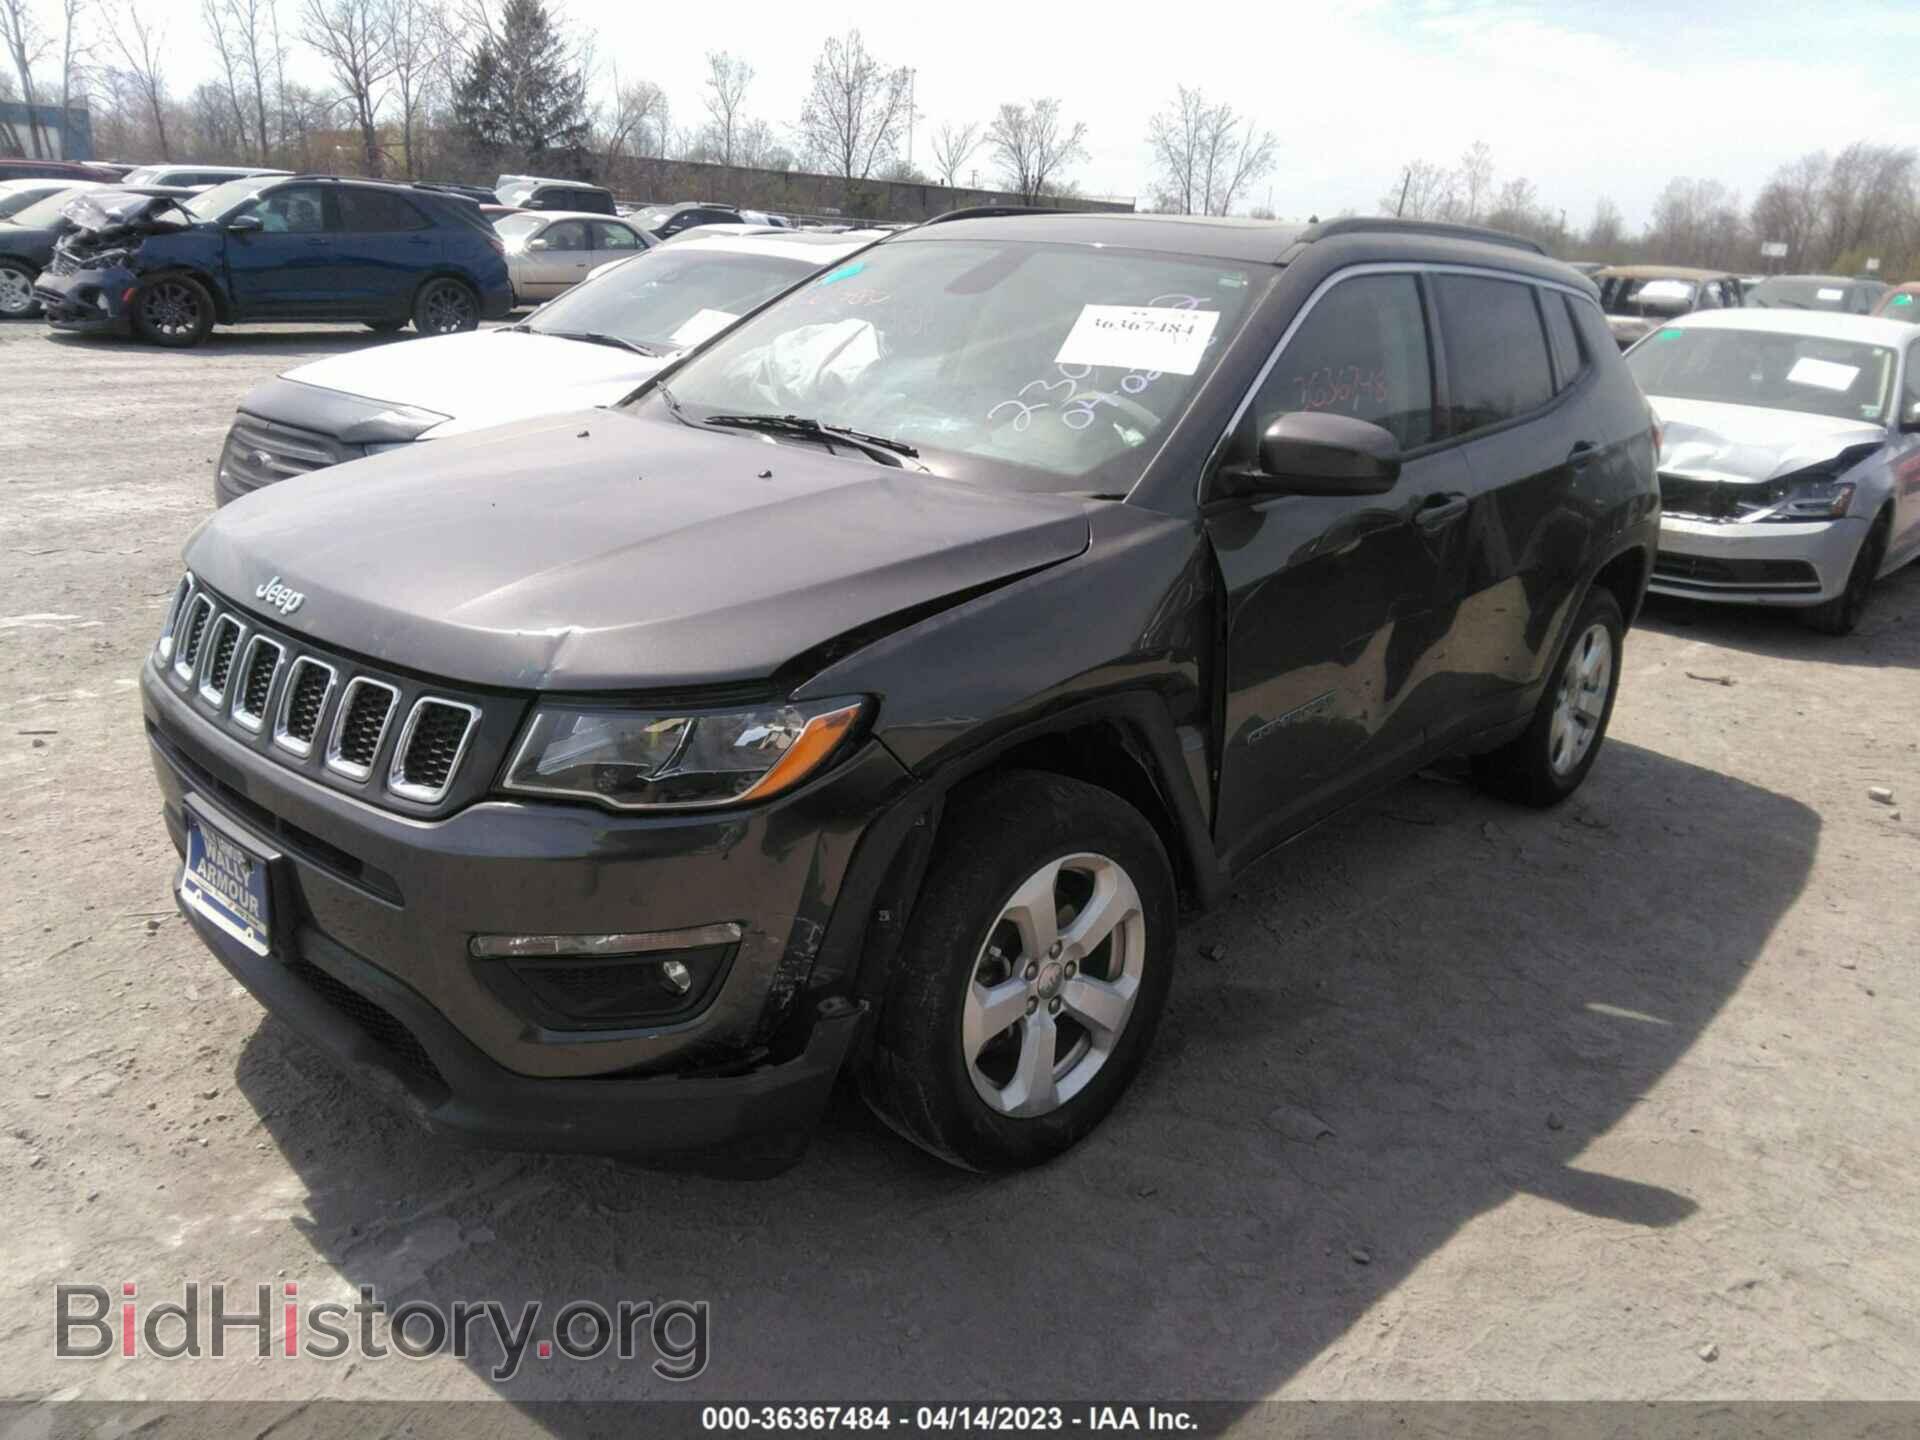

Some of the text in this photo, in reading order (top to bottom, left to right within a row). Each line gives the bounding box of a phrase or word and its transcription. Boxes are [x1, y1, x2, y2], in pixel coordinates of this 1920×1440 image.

[256, 575, 305, 615] Jeep
[197, 857, 260, 917] ARMOUR
[204, 836, 250, 887] WALLY
